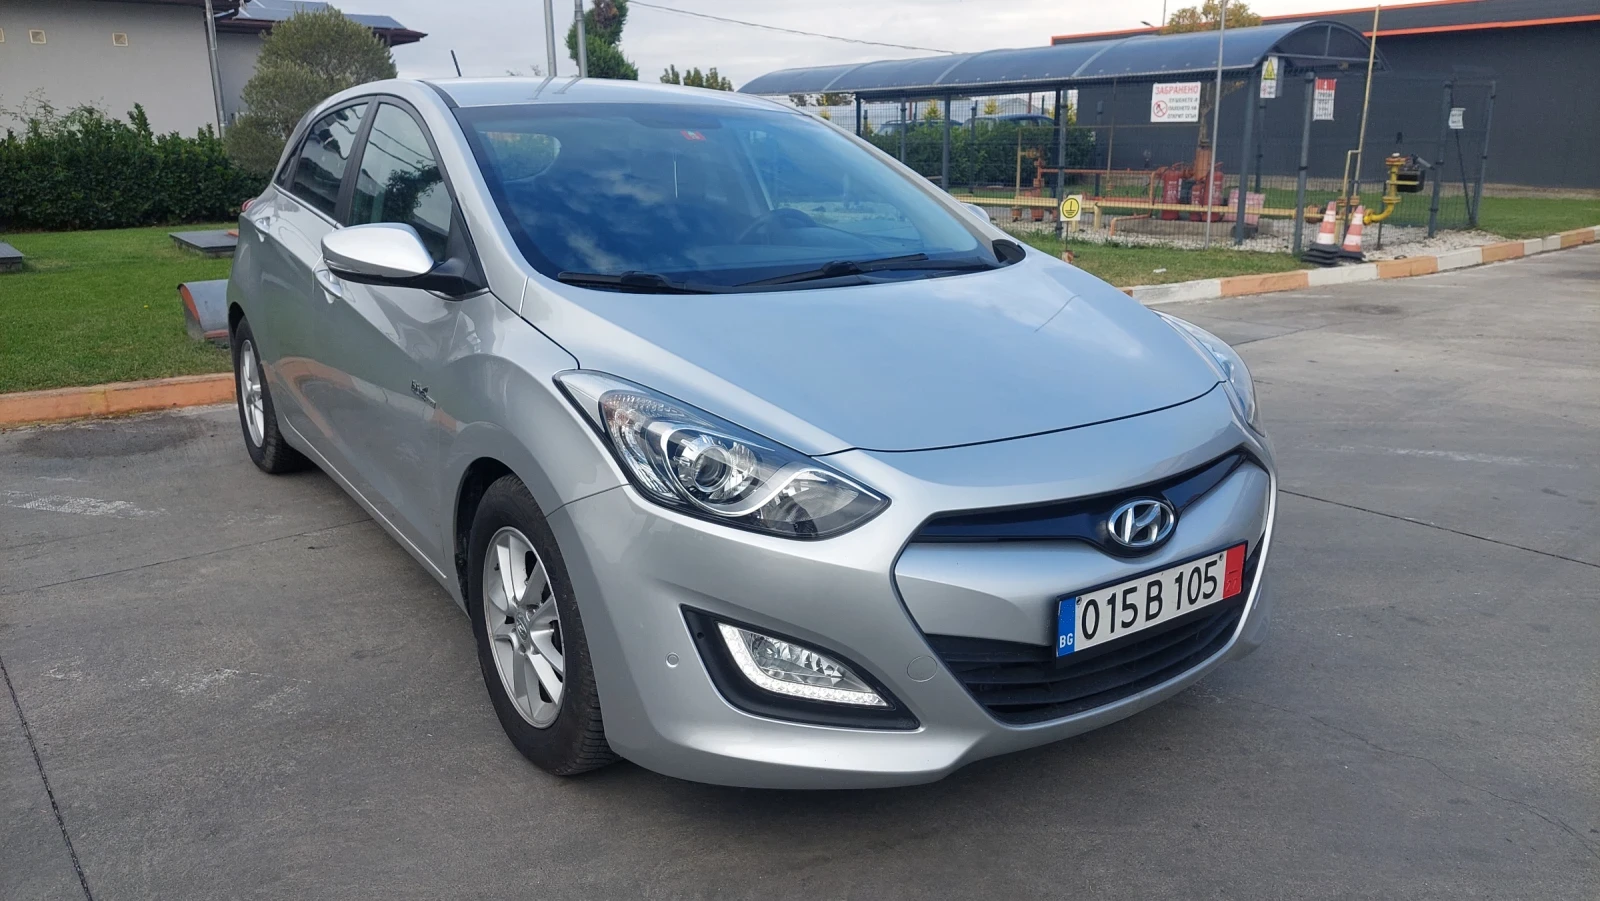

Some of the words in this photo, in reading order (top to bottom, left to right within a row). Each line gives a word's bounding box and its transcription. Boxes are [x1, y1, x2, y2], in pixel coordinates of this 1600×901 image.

[1155, 85, 1199, 95] ЗАБРАНЕНО
[1059, 632, 1074, 648] BG
[1174, 559, 1218, 611] 105
